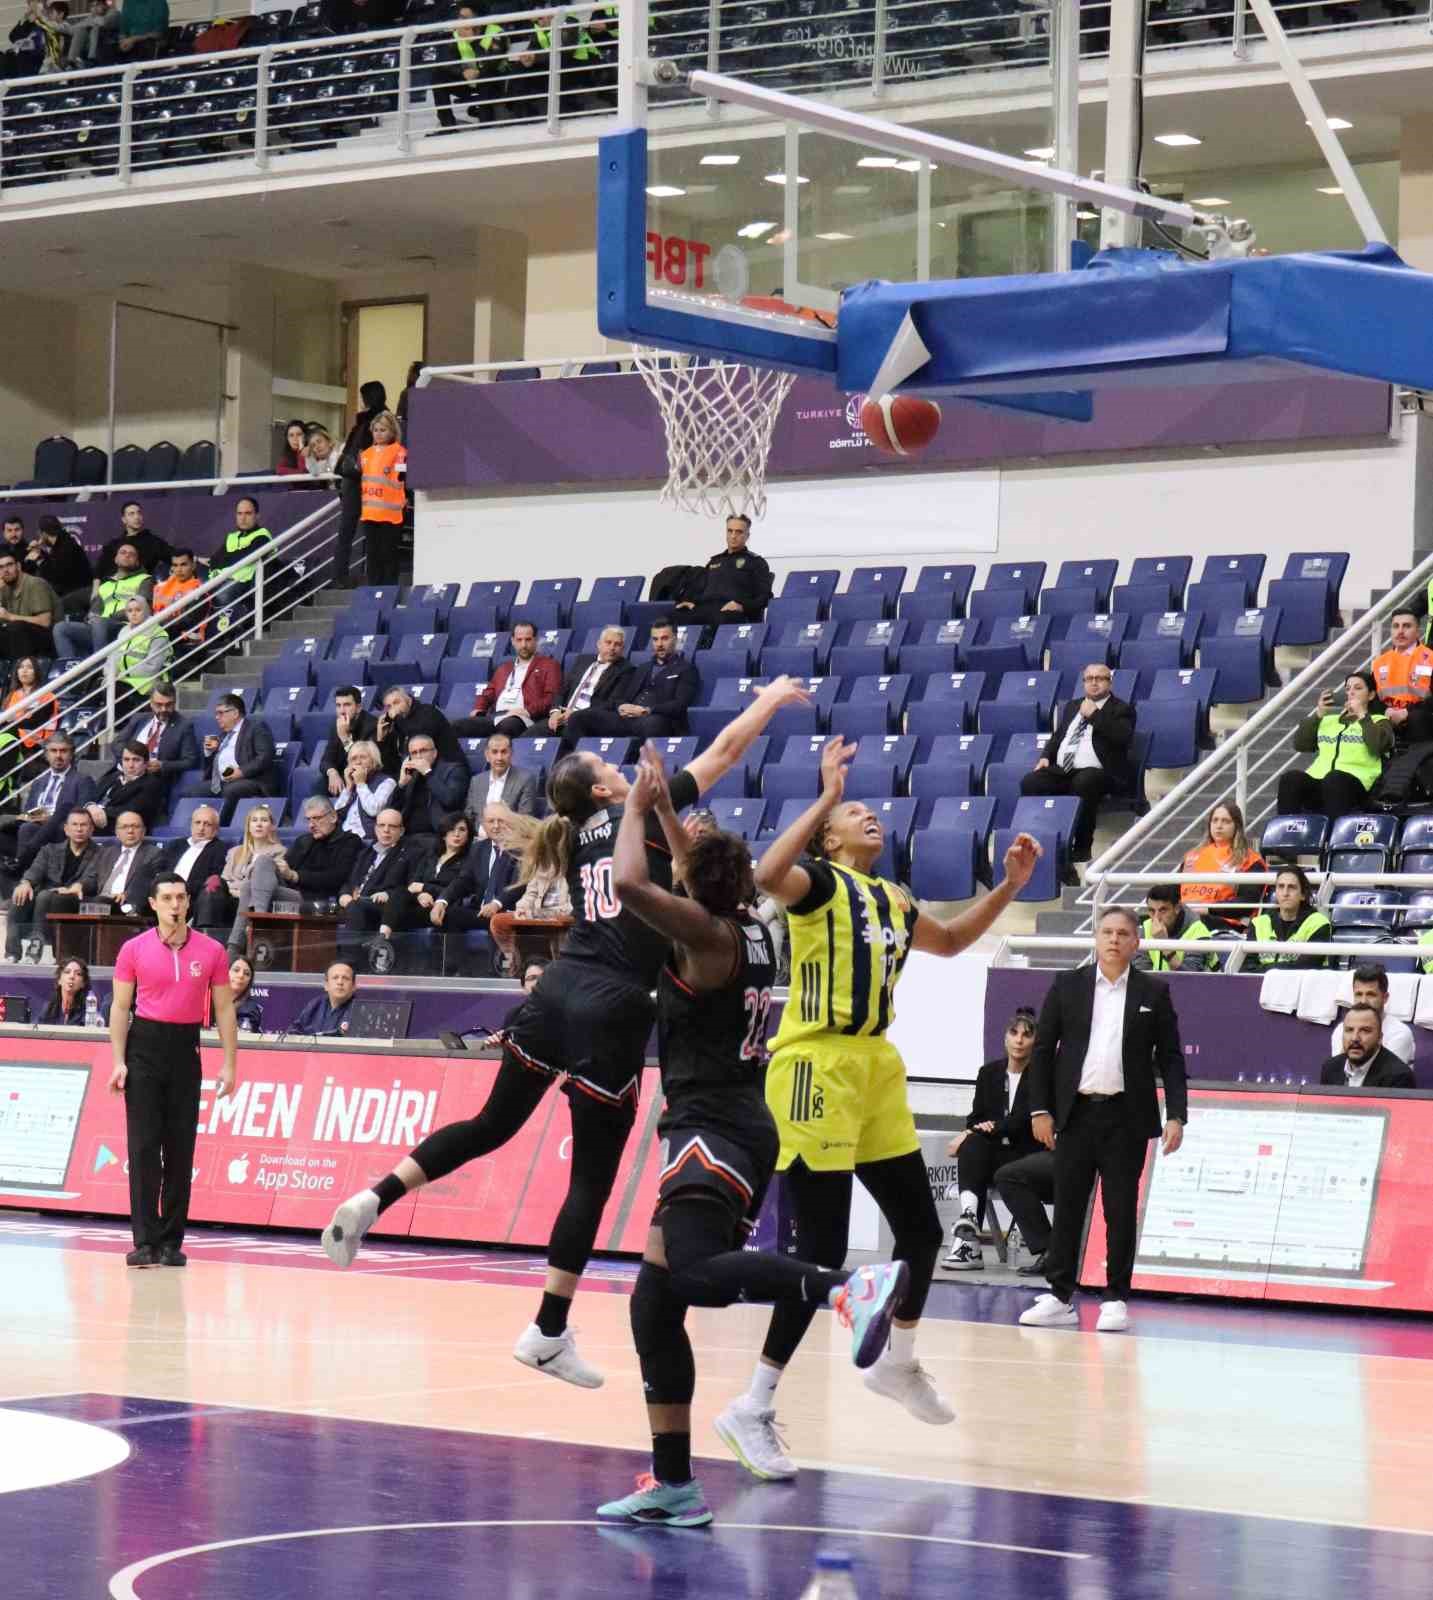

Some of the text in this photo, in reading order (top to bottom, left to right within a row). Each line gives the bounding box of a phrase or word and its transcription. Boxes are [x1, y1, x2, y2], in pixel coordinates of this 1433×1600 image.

[580, 856, 622, 922] 10
[196, 1076, 439, 1147] EMEN İNDİR!
[813, 1084, 824, 1119] DSV
[260, 1153, 337, 1169] Download on the
[254, 1168, 335, 1191] App Store
